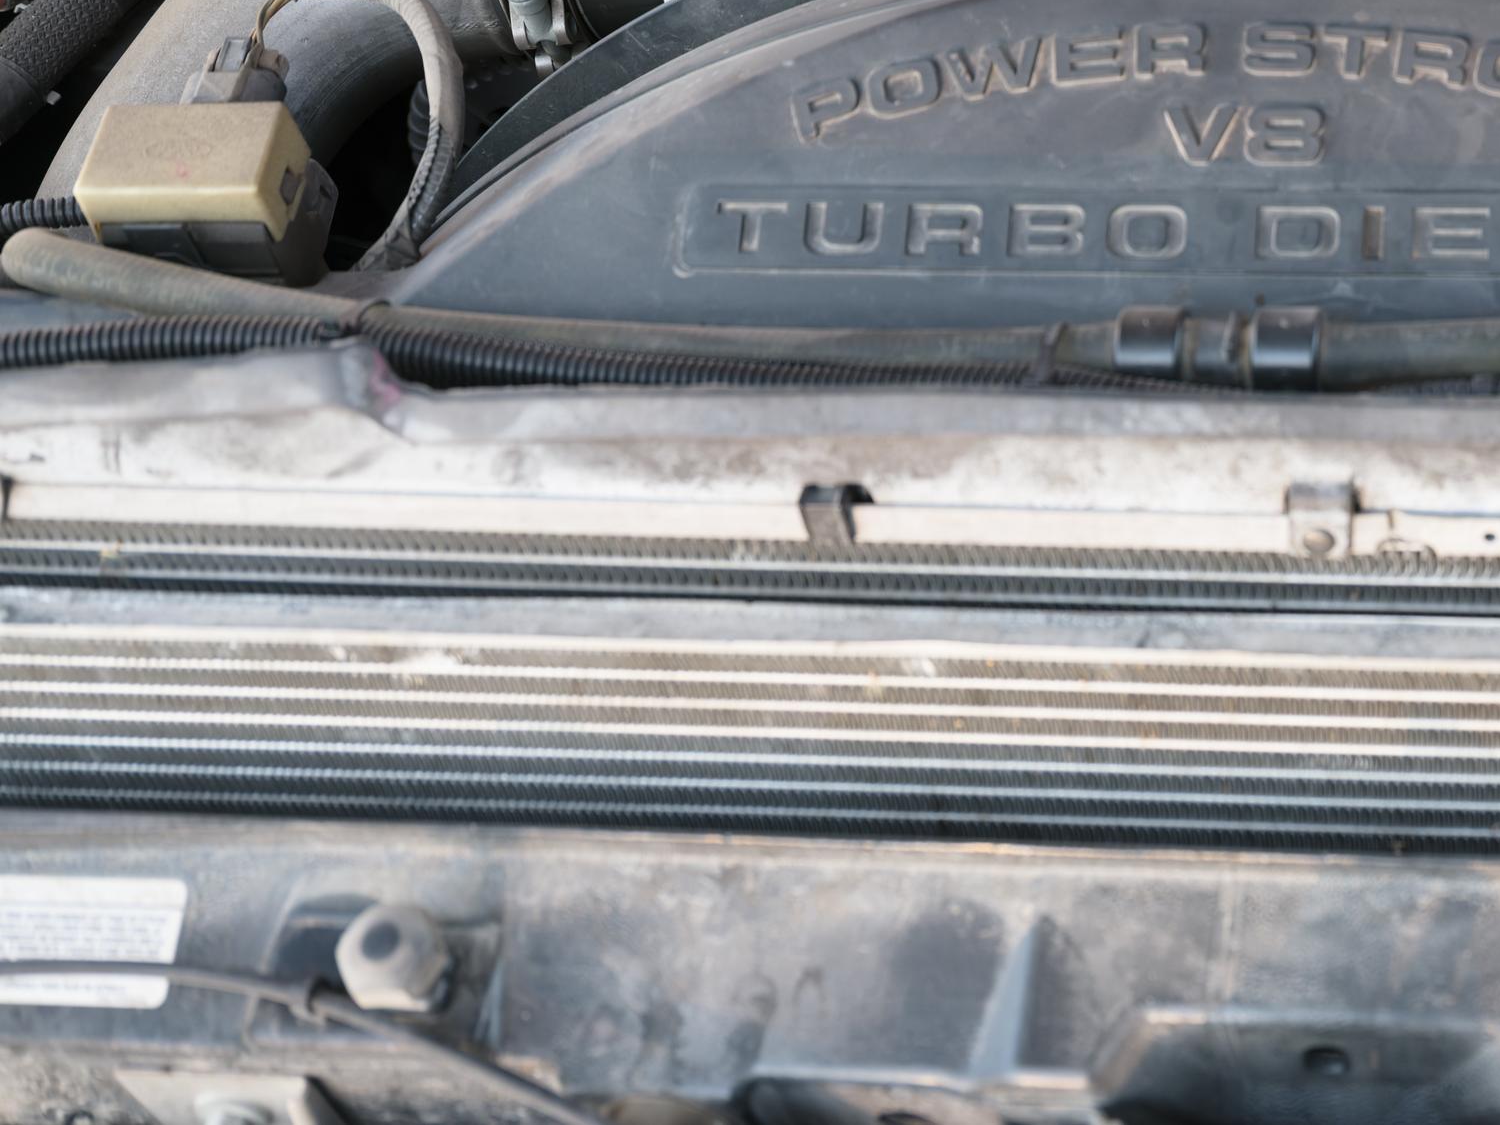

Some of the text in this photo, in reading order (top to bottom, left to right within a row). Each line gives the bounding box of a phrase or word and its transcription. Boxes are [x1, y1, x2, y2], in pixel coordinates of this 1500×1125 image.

[790, 21, 1208, 145] POWER
[1162, 102, 1326, 167] V8
[716, 201, 1189, 260] TURBO
